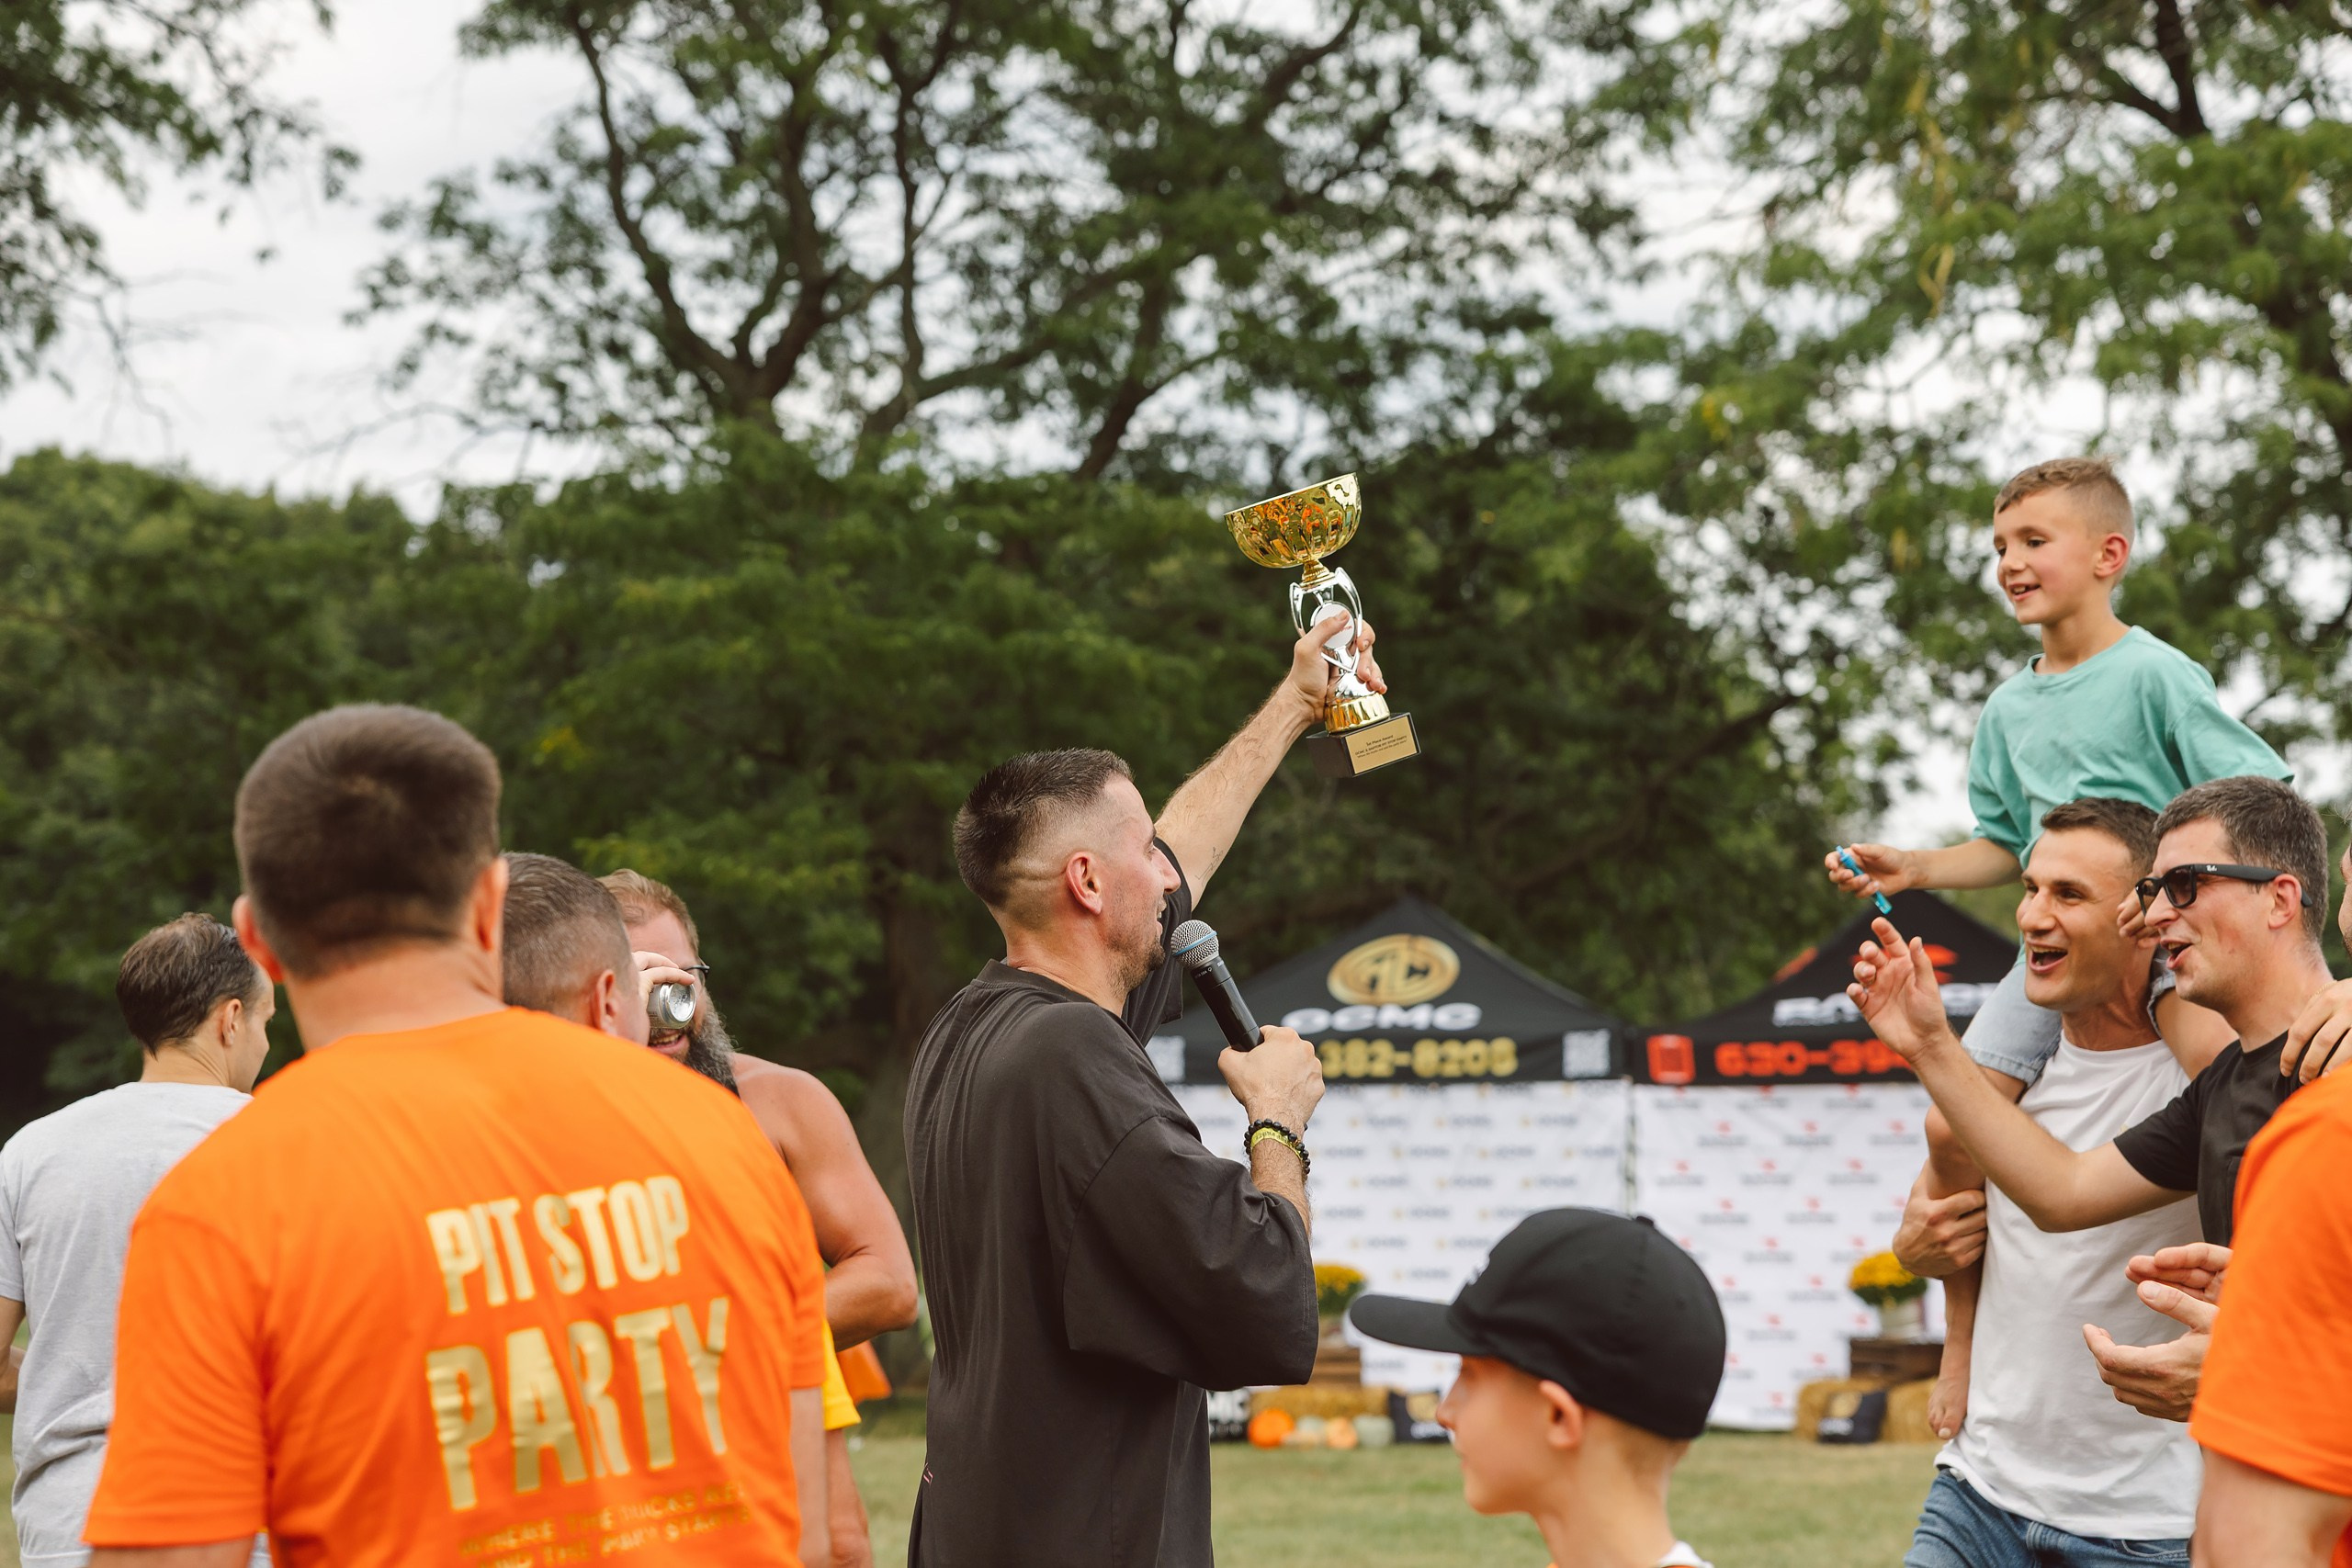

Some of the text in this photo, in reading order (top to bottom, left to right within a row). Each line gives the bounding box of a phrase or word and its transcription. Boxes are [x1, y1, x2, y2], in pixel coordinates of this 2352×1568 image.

[426, 1174, 690, 1315] PIT STOP
[425, 1296, 730, 1512] PARTY
